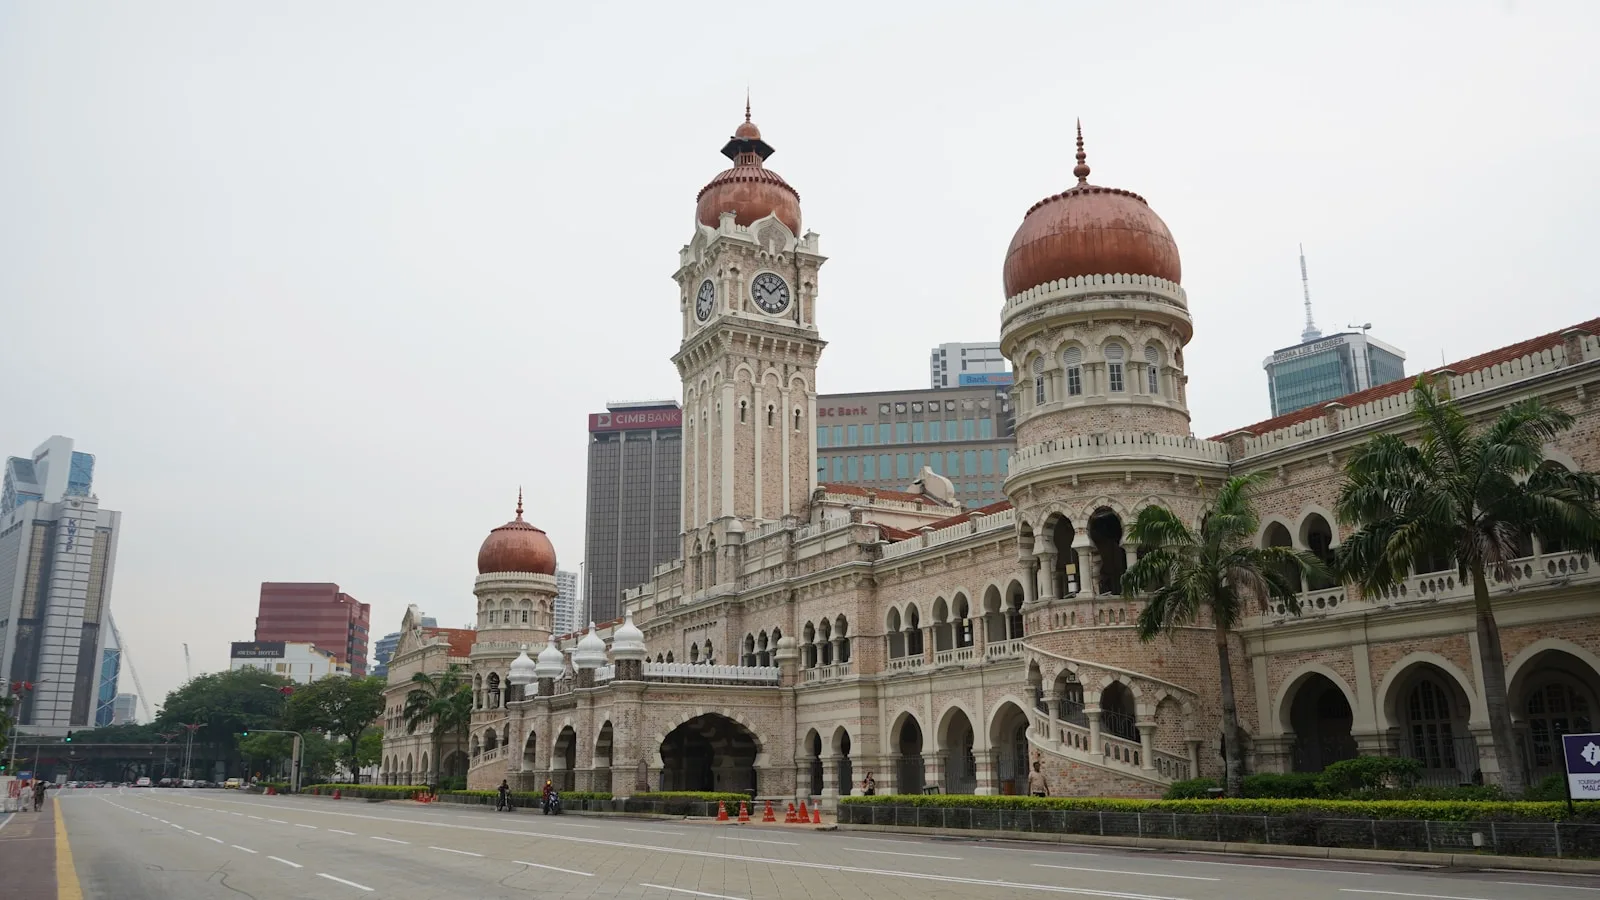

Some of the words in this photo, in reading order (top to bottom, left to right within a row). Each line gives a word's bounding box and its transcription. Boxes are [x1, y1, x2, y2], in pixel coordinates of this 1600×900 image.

[1272, 351, 1297, 362] WISMA
[1298, 346, 1312, 356] LEE
[1314, 338, 1344, 352] RUBBER
[616, 414, 646, 424] CIMB
[647, 413, 678, 423] BANK
[838, 406, 868, 416] Bank
[66, 518, 77, 552] KWSP
